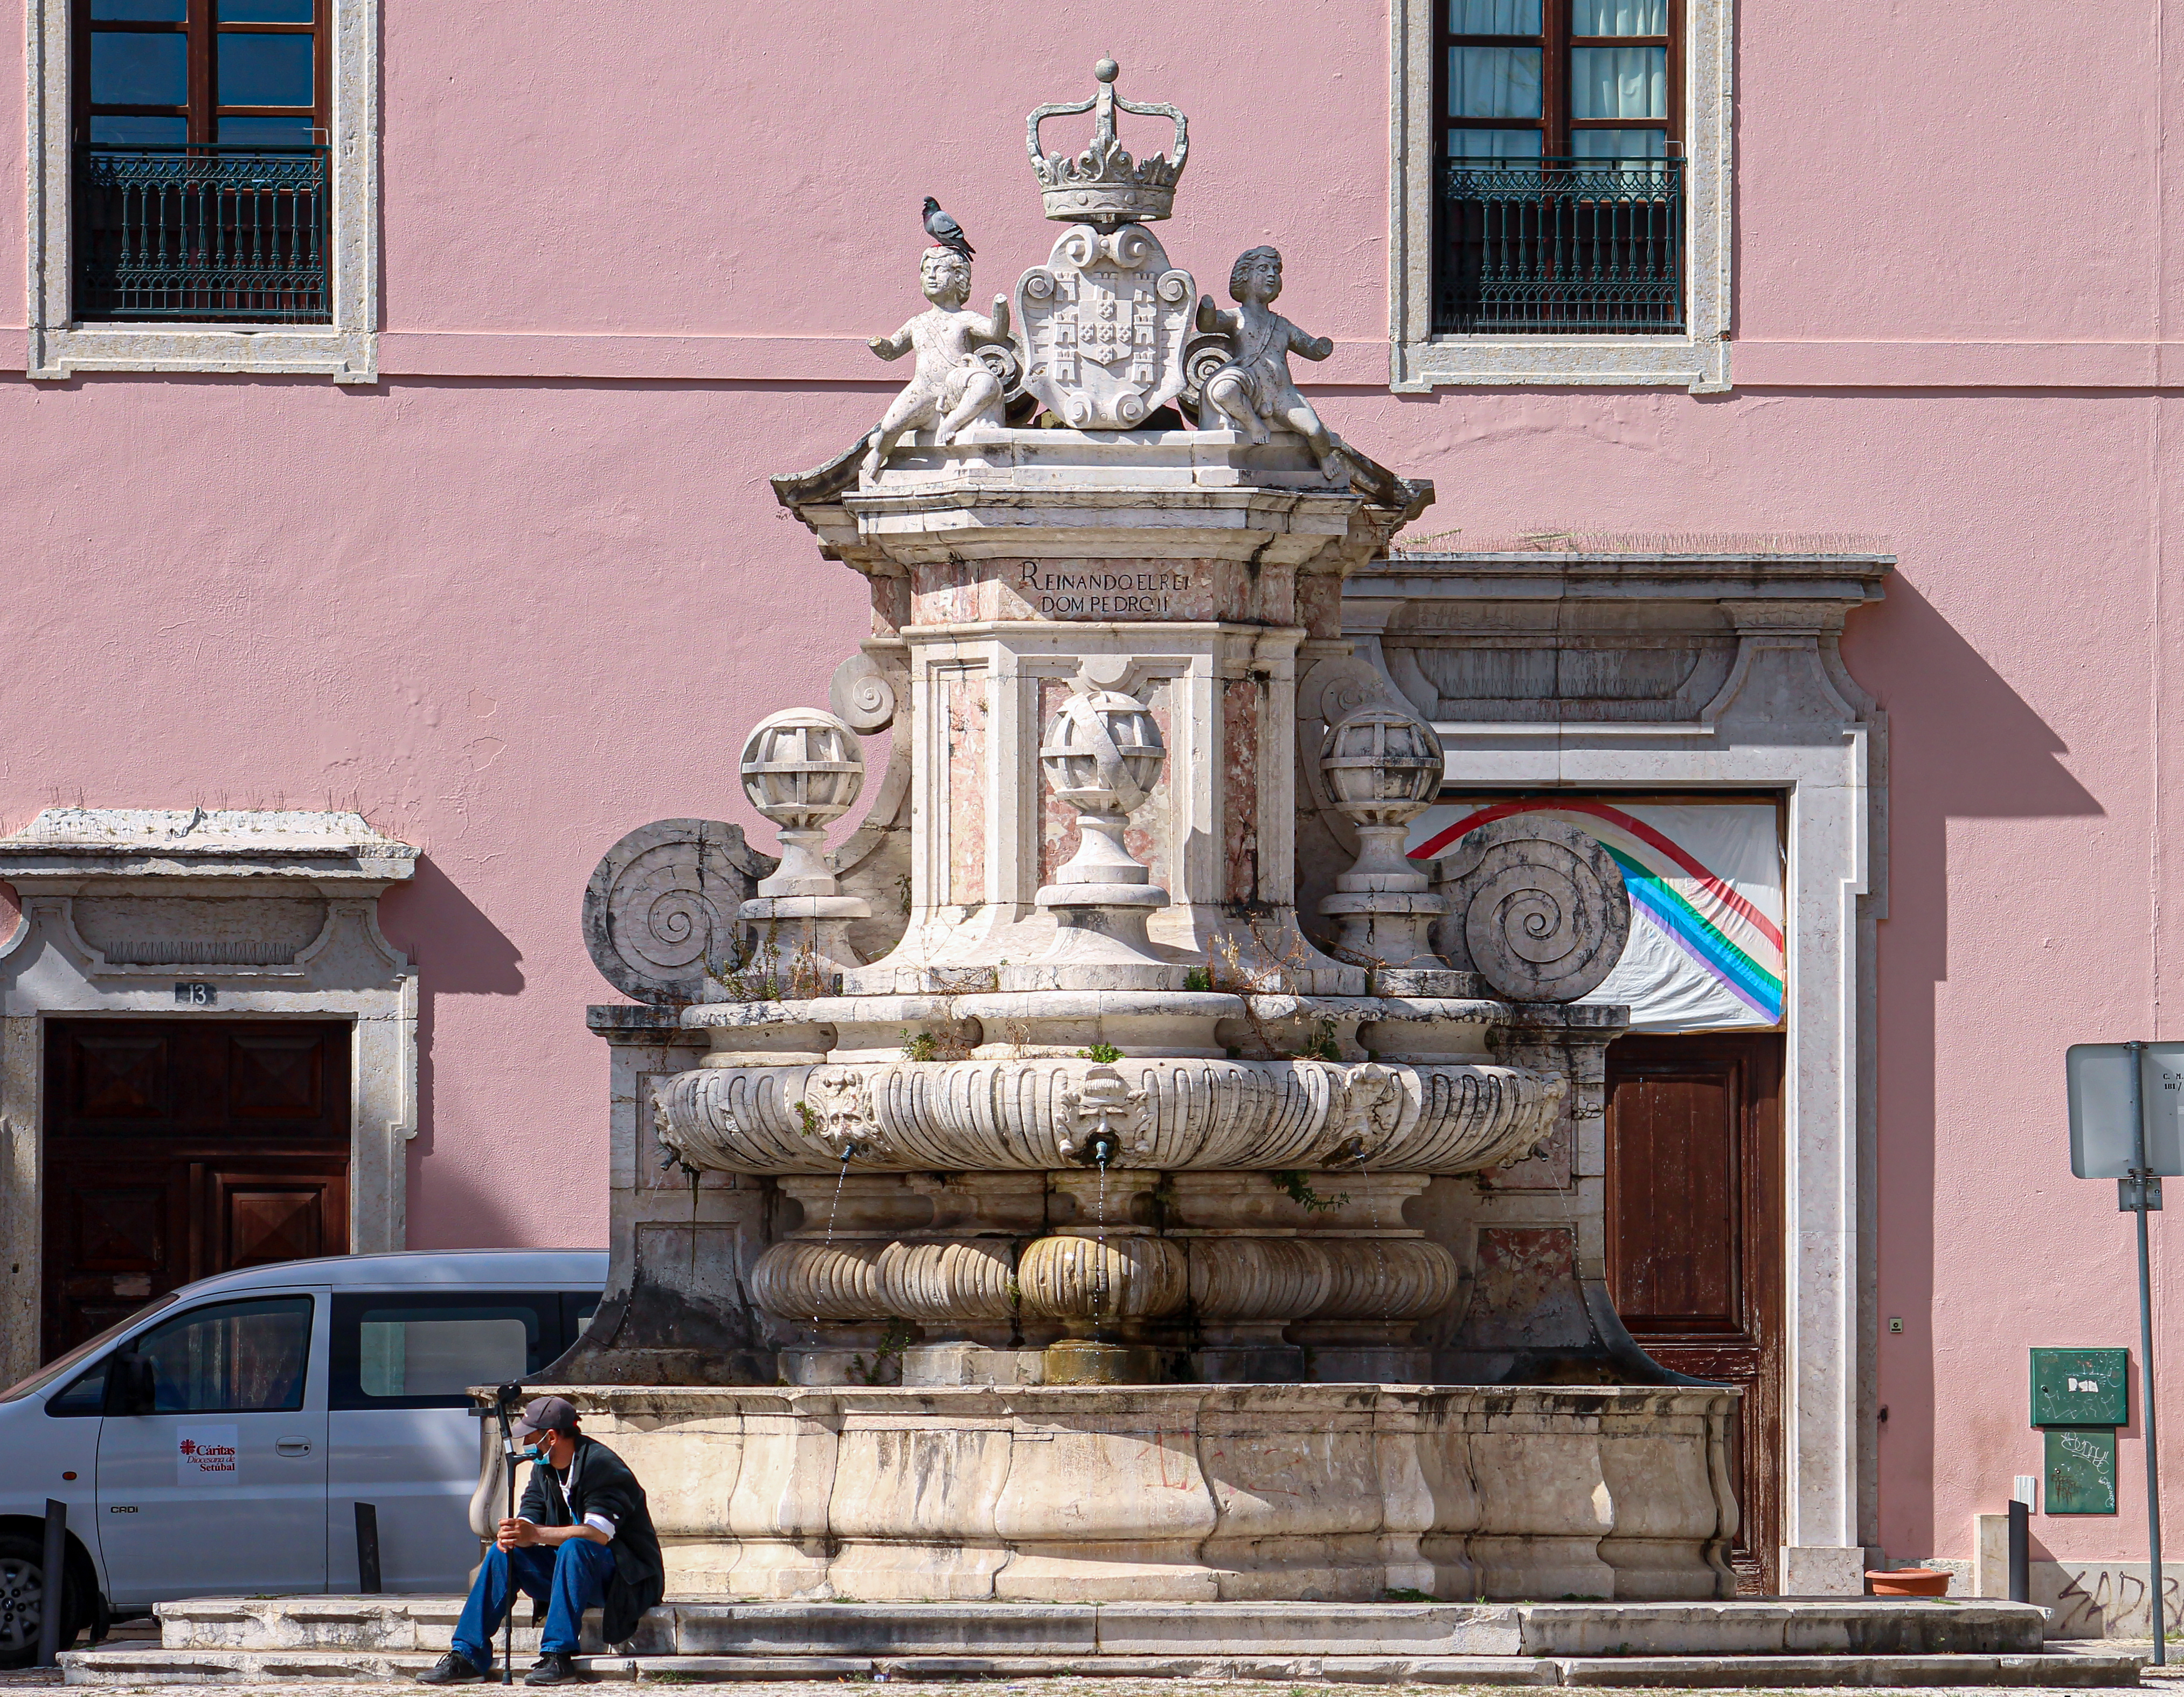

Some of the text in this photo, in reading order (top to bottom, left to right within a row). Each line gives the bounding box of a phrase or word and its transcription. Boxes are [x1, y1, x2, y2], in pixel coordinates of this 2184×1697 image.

[1042, 596, 1084, 613] DOM
[189, 984, 206, 1005] 13
[196, 1445, 235, 1456] Cáritas
[186, 1456, 224, 1464] Diocesana
[200, 1463, 235, 1472] Setúbal
